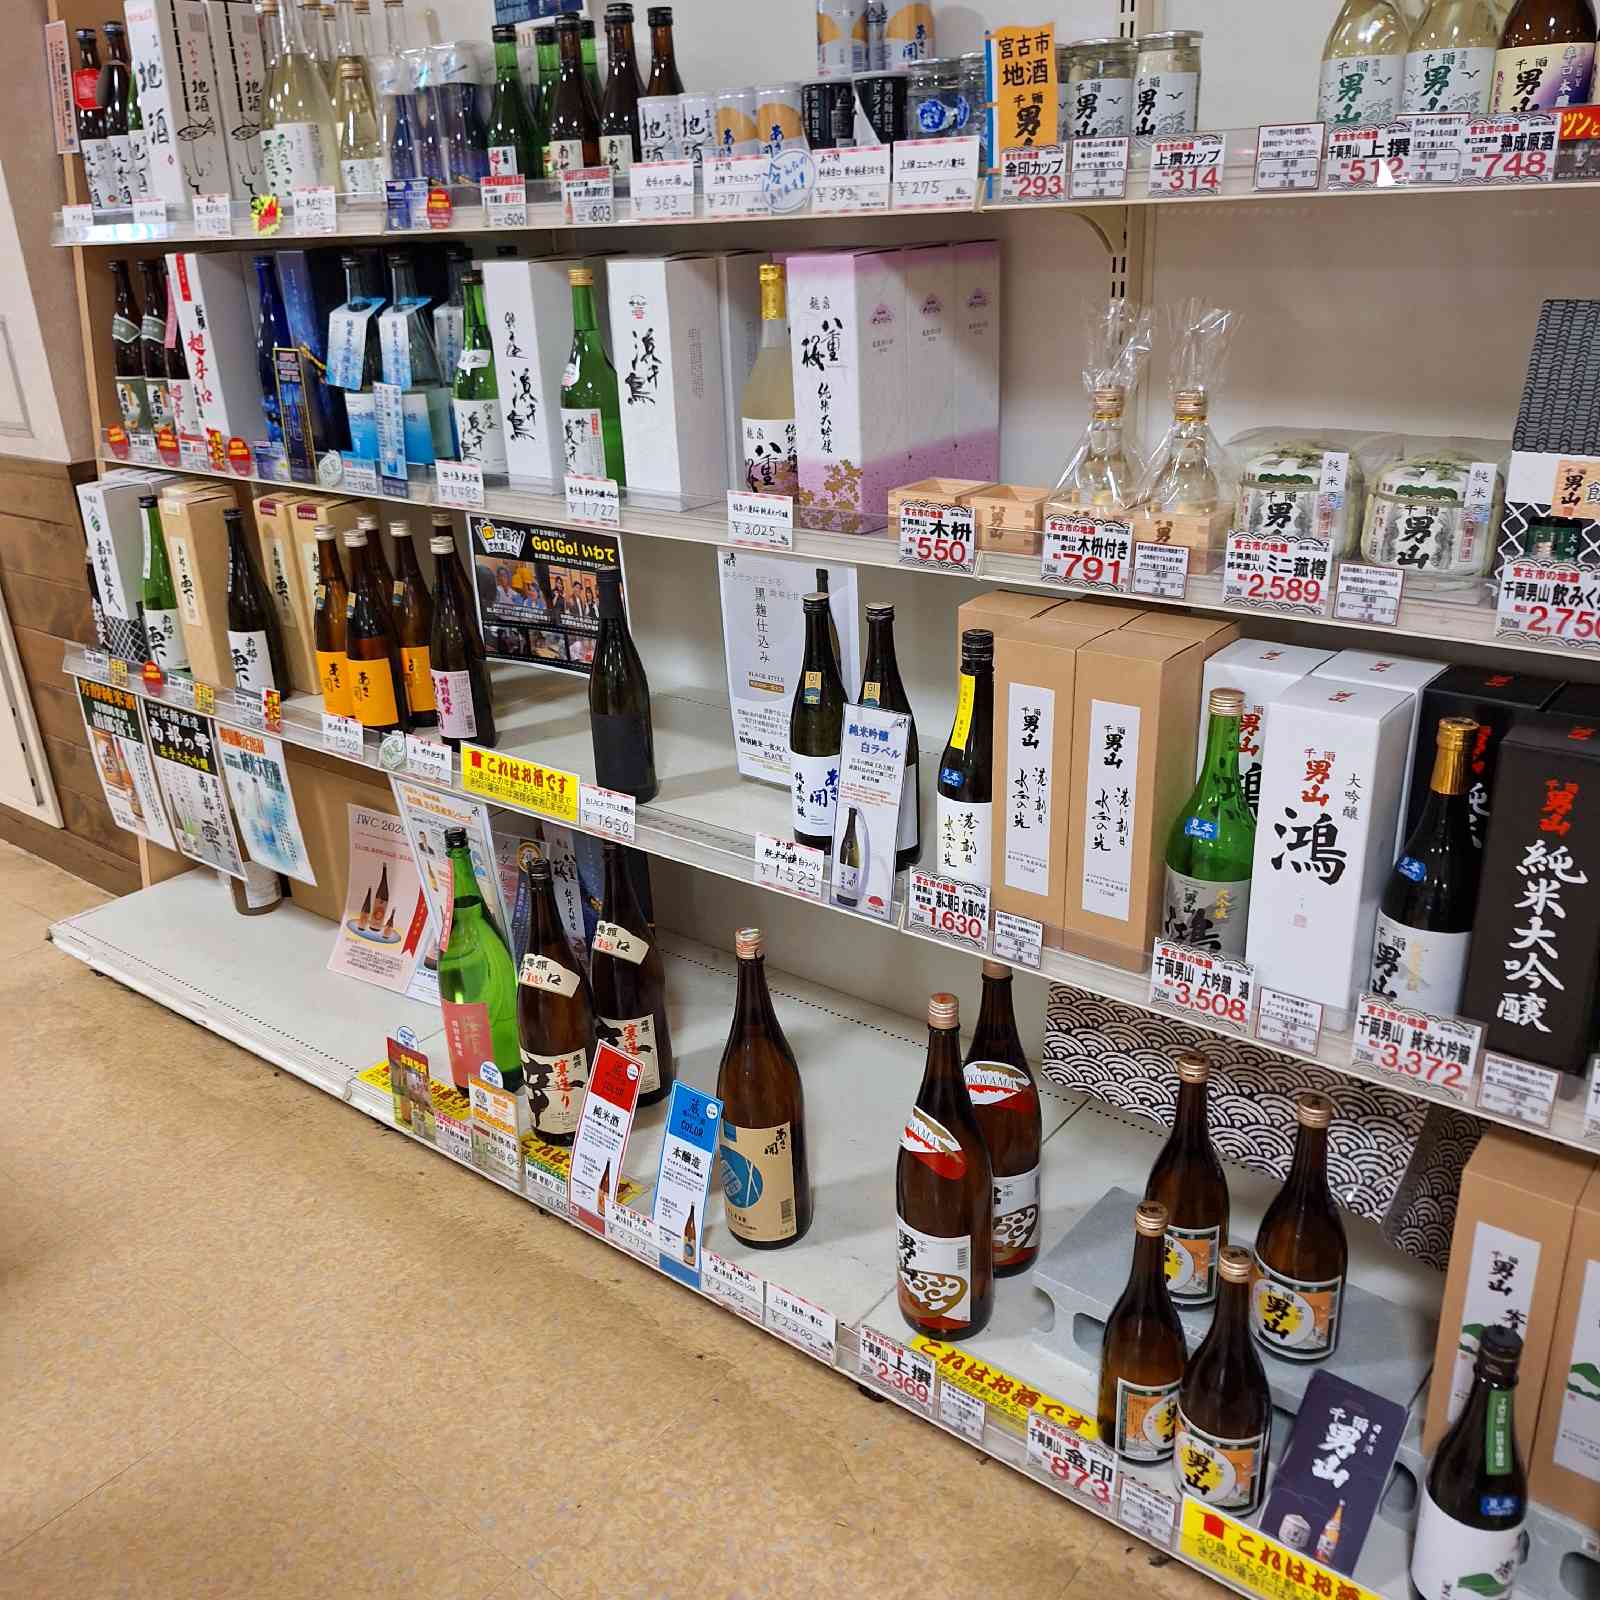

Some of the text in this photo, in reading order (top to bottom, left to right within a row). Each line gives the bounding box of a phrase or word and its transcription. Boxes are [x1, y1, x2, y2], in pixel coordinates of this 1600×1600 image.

[998, 33, 1051, 60] 宮古市
[1002, 58, 1049, 86] 地酒
[1333, 72, 1365, 124] 男山
[1328, 144, 1361, 159] 千両男山
[1363, 138, 1411, 158] 上撰
[1500, 131, 1555, 151] 熟成原酒
[1005, 159, 1064, 177] 金印カップ
[1154, 150, 1220, 166] 上撰カップ
[1349, 156, 1404, 183] 512
[1483, 152, 1546, 177] 748
[1018, 175, 1065, 197] 293
[1169, 167, 1217, 191] 314
[1561, 474, 1585, 506] 男山
[929, 520, 973, 542] 木枡
[1234, 540, 1288, 553] 宮古市の地酒
[1397, 515, 1435, 569] 男山
[581, 544, 616, 562] いわて
[917, 536, 966, 564] 550
[1078, 536, 1129, 560] 木枡付き
[1061, 553, 1121, 585] 791
[1513, 567, 1580, 582] 宮古市の地酒
[1247, 573, 1321, 604] 2,589
[1503, 581, 1600, 609] 千両男山 飲みく
[754, 586, 771, 665] 黒麹仕込み
[1527, 606, 1600, 638] 2,75
[1021, 714, 1041, 750] 男山
[860, 743, 901, 760] 白ラベル
[1103, 733, 1124, 770] 男山
[487, 757, 568, 794] これはお酒です
[1301, 759, 1333, 807] 男山
[1341, 772, 1362, 821] 大吟醸
[1270, 806, 1348, 886] 鴻
[928, 906, 983, 939] 1,630
[1494, 838, 1590, 1035] 純米大吟醸
[1161, 947, 1213, 970] 宮古市の地酒
[1154, 955, 1195, 985] 千両男山
[1200, 970, 1232, 996] 大吟醸
[1174, 981, 1248, 1023] 3,508
[1367, 1004, 1428, 1030] 宮古市の地酒
[1358, 1014, 1471, 1065] 千両男山 純米大吟醸
[1380, 1042, 1464, 1089] 3,372
[592, 1103, 620, 1127] 純米酒
[671, 1145, 702, 1170] 本醸造
[1487, 1260, 1516, 1297] 男山
[1263, 1295, 1292, 1339] 男山
[877, 1362, 929, 1403] 2,369
[920, 1339, 1091, 1431] これはお酒です
[1065, 1448, 1113, 1482] 金印
[1183, 1447, 1212, 1495] 男山
[1311, 1421, 1362, 1489] 男山
[1051, 1456, 1113, 1505] 873
